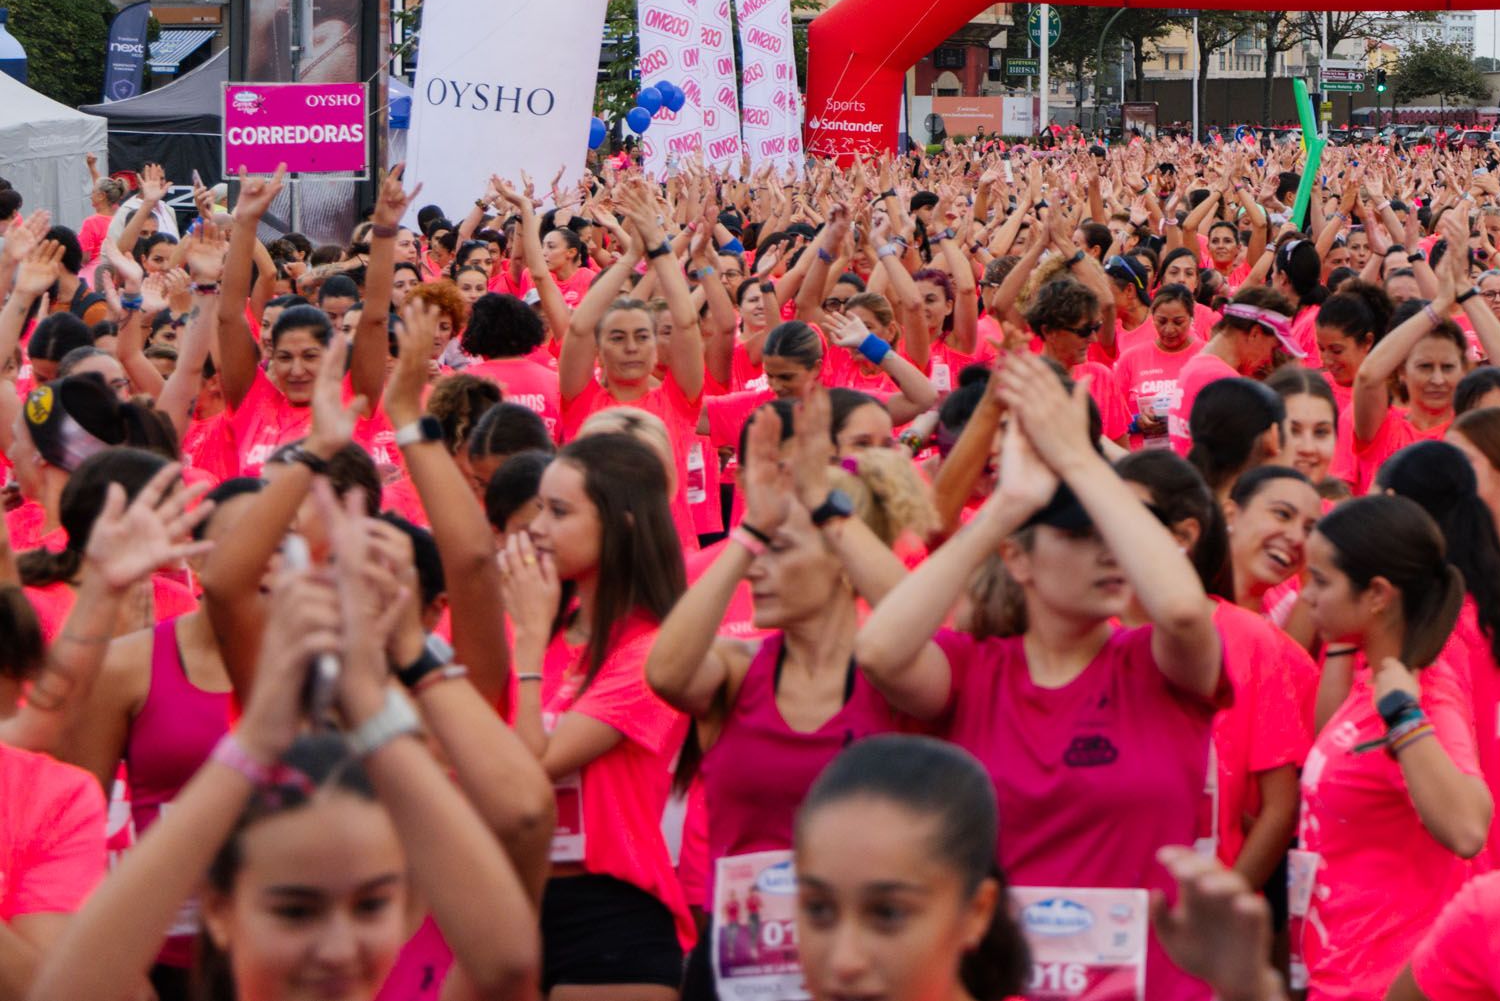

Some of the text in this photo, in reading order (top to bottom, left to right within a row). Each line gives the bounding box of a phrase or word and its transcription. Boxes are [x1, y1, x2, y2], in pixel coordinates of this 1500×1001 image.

[1030, 10, 1058, 25] HOEL
[110, 42, 144, 54] next
[1009, 66, 1036, 74] BRISA
[305, 93, 361, 108] OYSHO
[426, 77, 556, 117] OYSHO
[826, 98, 866, 113] Sports
[821, 118, 884, 133] Santander
[228, 123, 364, 146] CORREDORAS
[763, 921, 800, 948] 01
